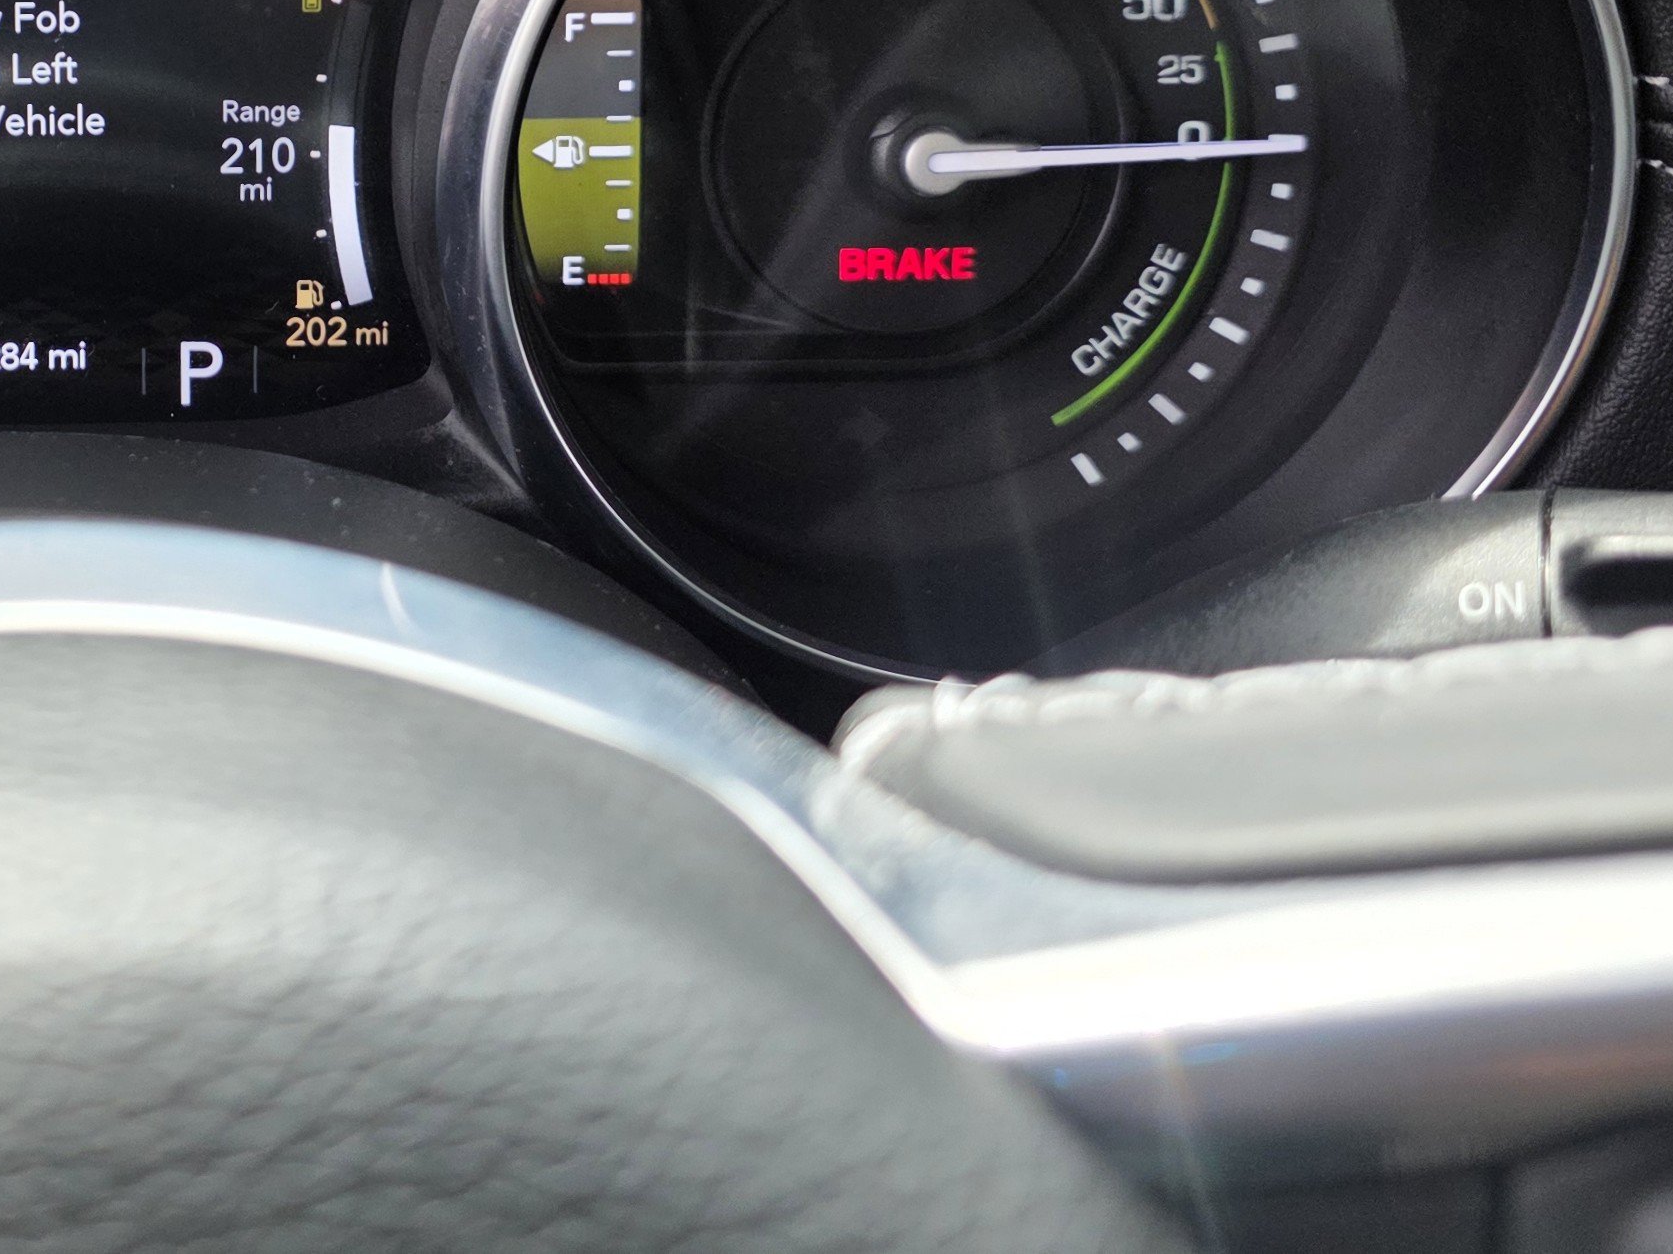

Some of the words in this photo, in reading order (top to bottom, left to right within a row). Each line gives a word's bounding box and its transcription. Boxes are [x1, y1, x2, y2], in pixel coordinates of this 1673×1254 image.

[14, 0, 81, 34] Fob
[564, 12, 586, 43] F
[11, 51, 78, 85] Left
[1157, 54, 1205, 85] 25
[222, 99, 301, 128] Range
[220, 136, 296, 175] 210
[239, 176, 273, 202] mi
[562, 255, 585, 286] E
[838, 246, 975, 282] BRAKE
[1072, 243, 1187, 378] CHARGE
[285, 316, 348, 347] 202
[355, 320, 389, 346] mi
[48, 340, 87, 371] mi
[180, 340, 224, 407] P
[1458, 581, 1526, 621] ON
